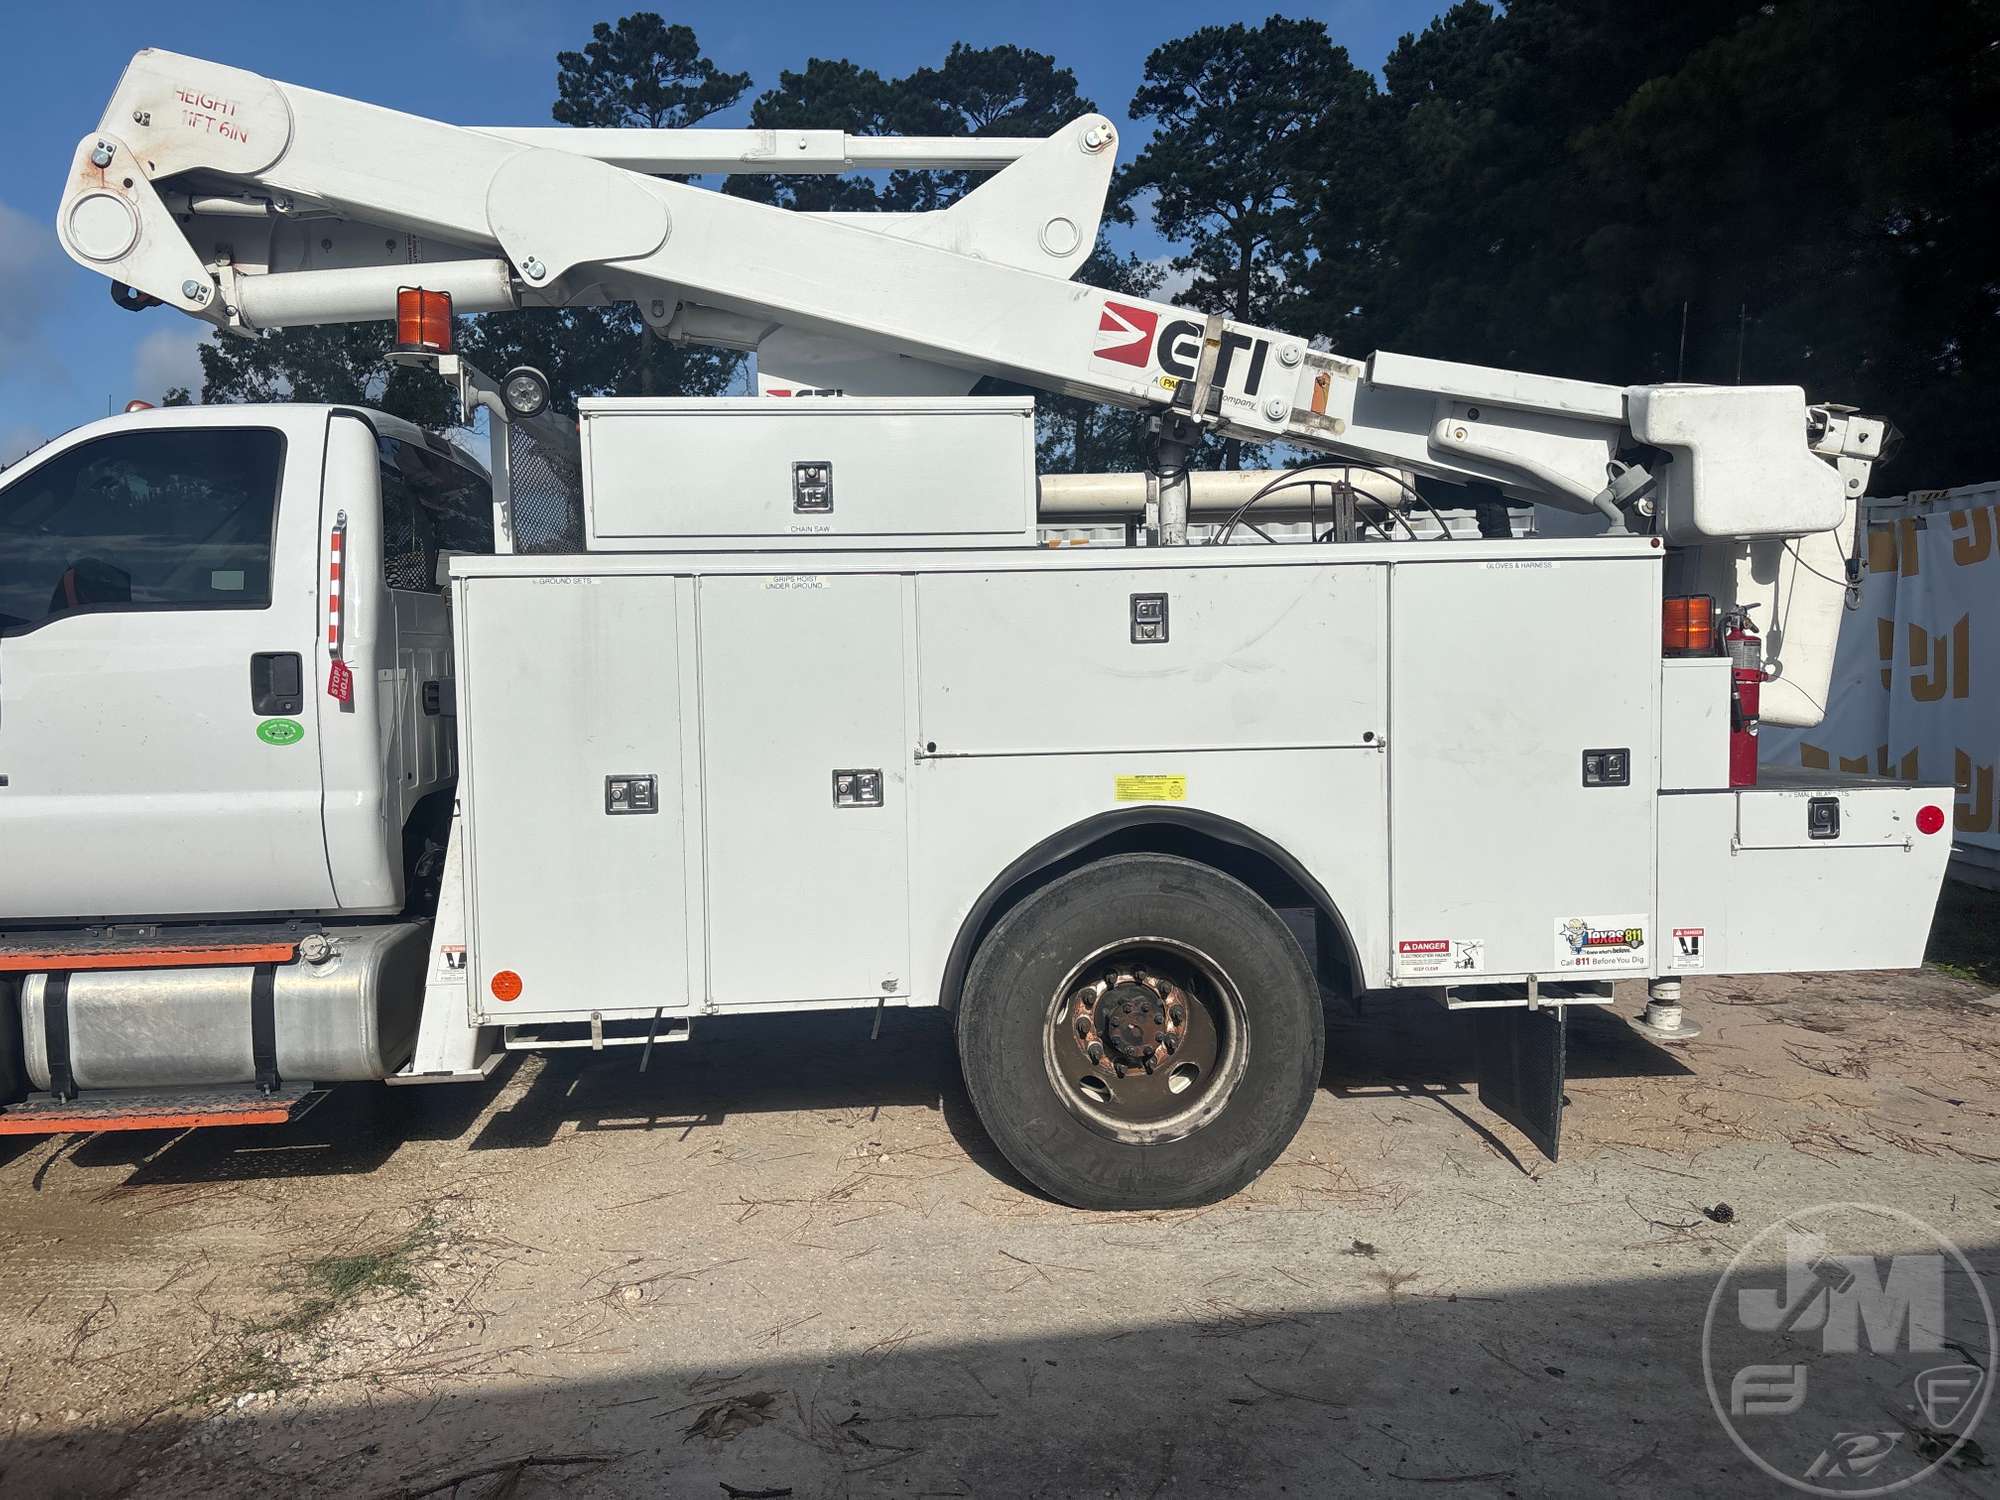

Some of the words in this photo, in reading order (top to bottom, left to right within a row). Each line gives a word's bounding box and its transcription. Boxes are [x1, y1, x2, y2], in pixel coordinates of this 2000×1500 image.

[1157, 319, 1269, 396] ETI
[1223, 395, 1257, 410] ompany
[790, 525, 813, 533] CHAIN
[814, 525, 831, 533] SAW
[539, 577, 572, 585] GROUND
[573, 577, 593, 585] SETS
[792, 582, 823, 590] GROUND
[1586, 929, 1624, 944] Texas
[1624, 927, 1642, 942] 811
[1411, 943, 1447, 951] DANGER
[1560, 958, 1574, 967] Call
[1575, 956, 1591, 966] 811
[1592, 957, 1617, 966] Before
[1617, 956, 1631, 965] You
[1631, 955, 1645, 965] Dig
